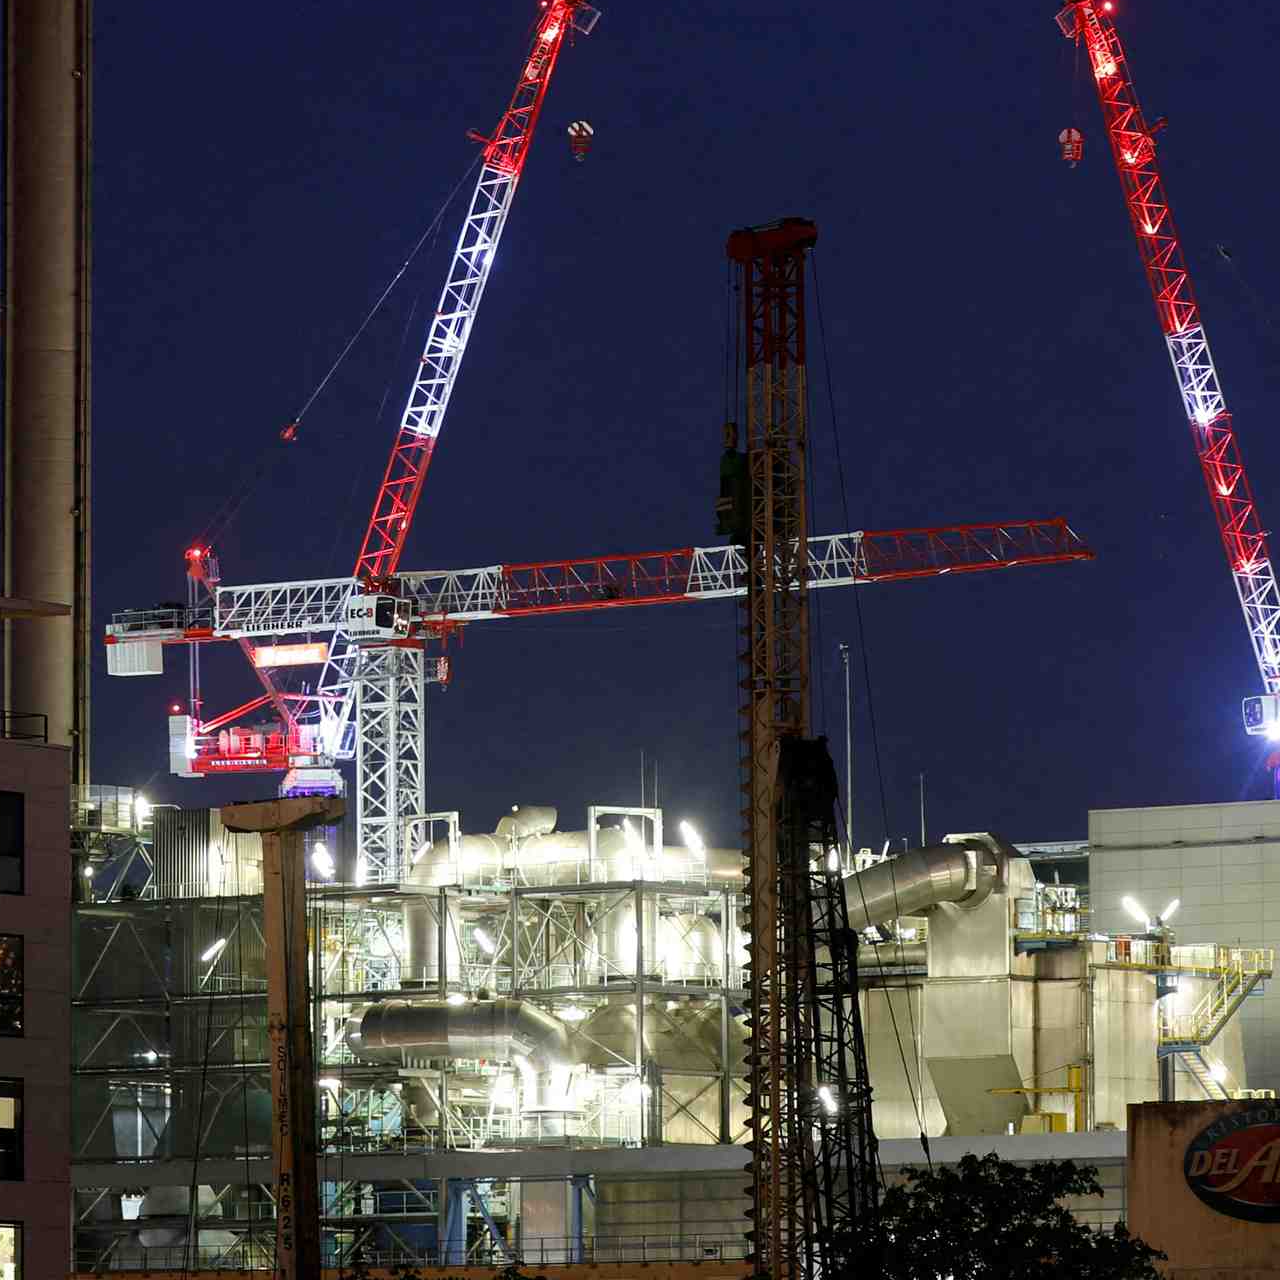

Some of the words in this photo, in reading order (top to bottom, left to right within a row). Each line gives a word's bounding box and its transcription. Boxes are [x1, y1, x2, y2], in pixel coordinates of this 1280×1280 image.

[350, 607, 374, 619] EC-B
[246, 621, 303, 632] LIEBHERR
[1187, 1147, 1242, 1176] DEL
